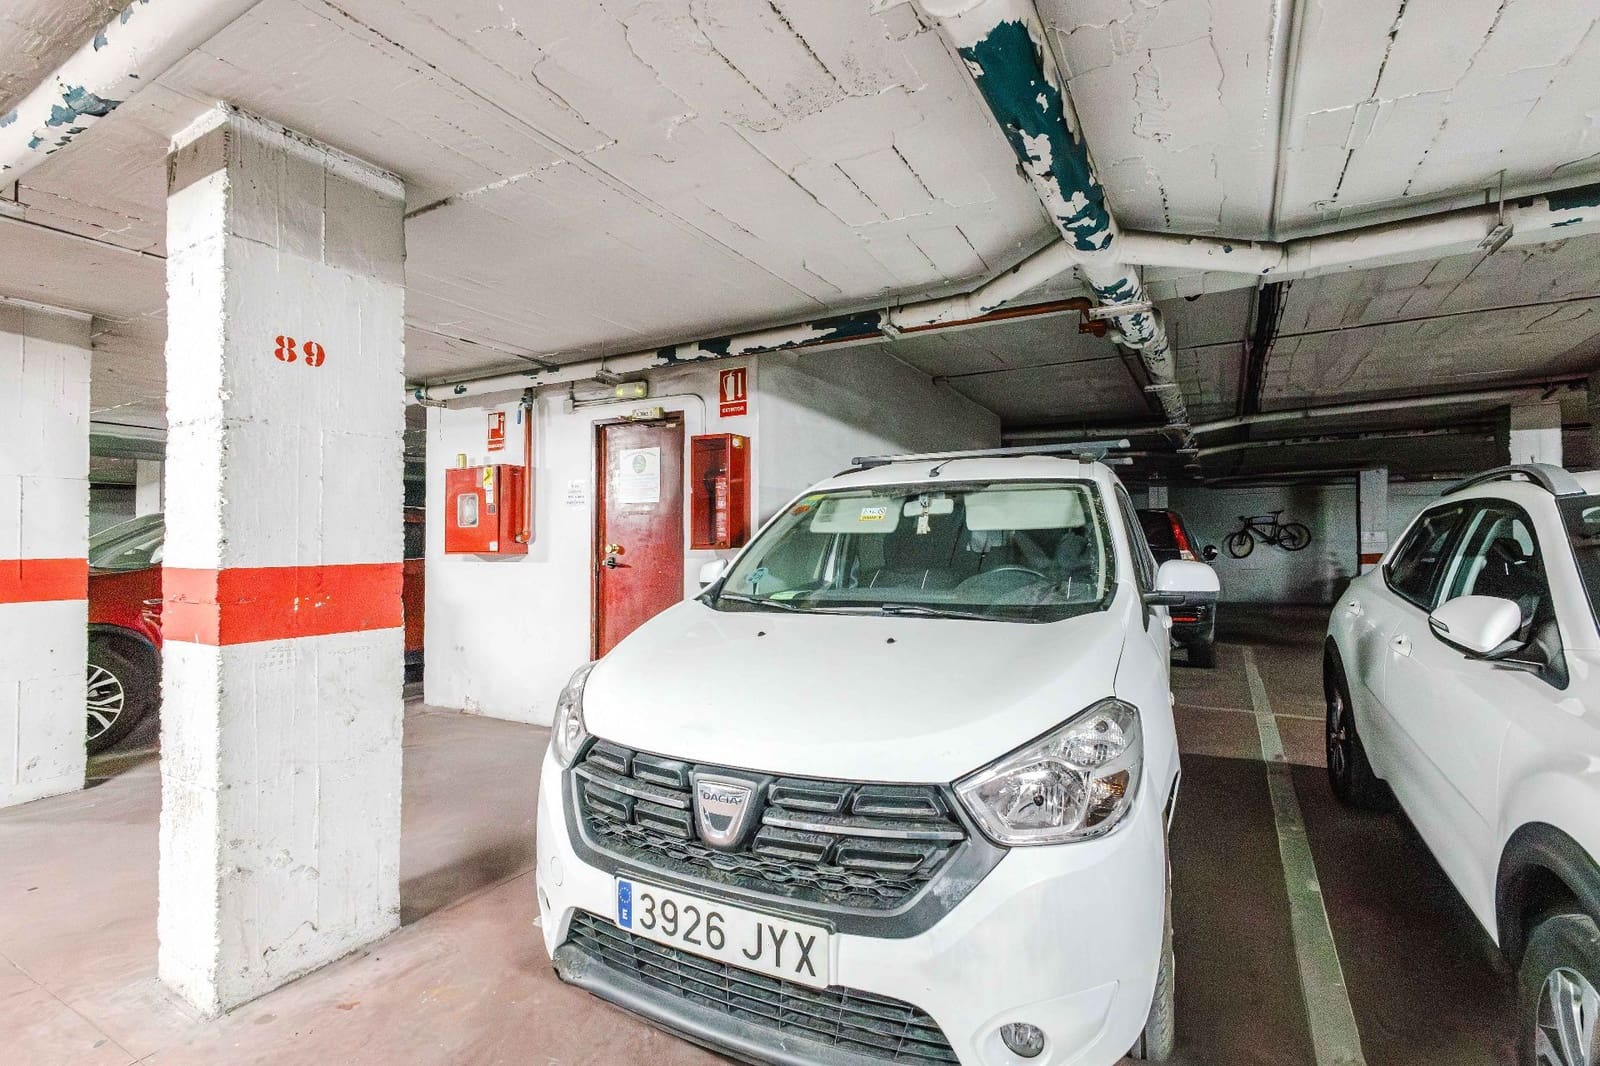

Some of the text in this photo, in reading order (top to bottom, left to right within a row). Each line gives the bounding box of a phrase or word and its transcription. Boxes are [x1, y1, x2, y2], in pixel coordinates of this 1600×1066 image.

[274, 335, 325, 367] 89
[703, 792, 738, 805] DACIA
[622, 909, 628, 920] E
[639, 893, 816, 977] 3926 JYX
